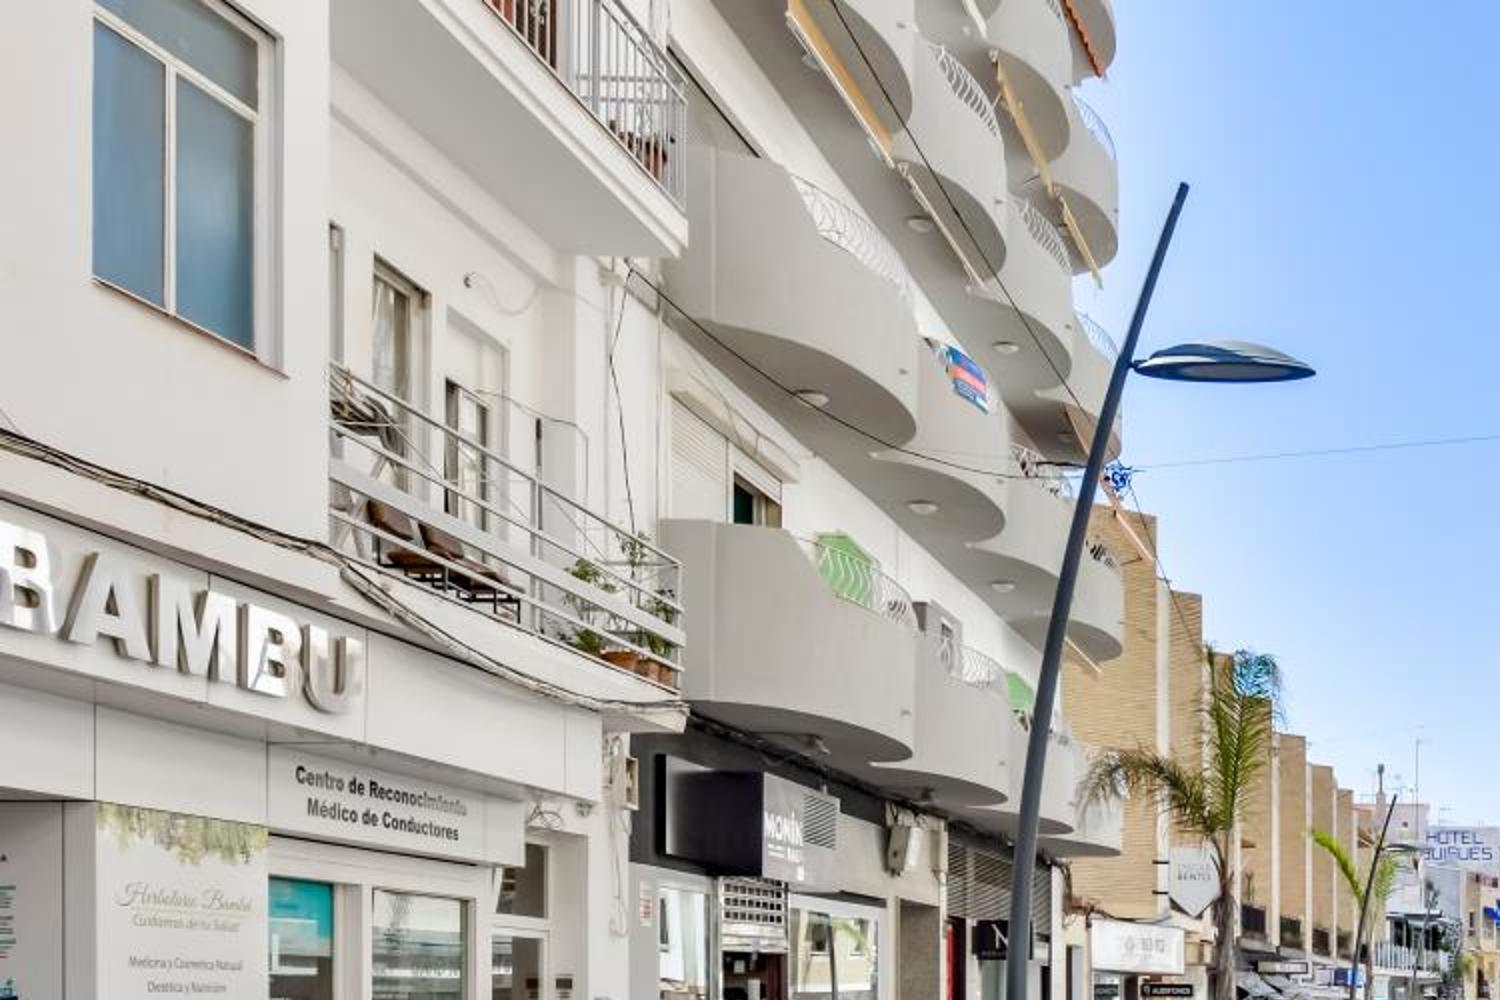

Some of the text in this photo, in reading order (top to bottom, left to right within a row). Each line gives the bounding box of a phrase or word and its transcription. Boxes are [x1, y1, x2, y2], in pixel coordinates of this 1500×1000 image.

[295, 765, 467, 816] Centro de Reconocimiento
[307, 797, 459, 841] Médico de Conductores
[1425, 831, 1484, 845] HOTEL
